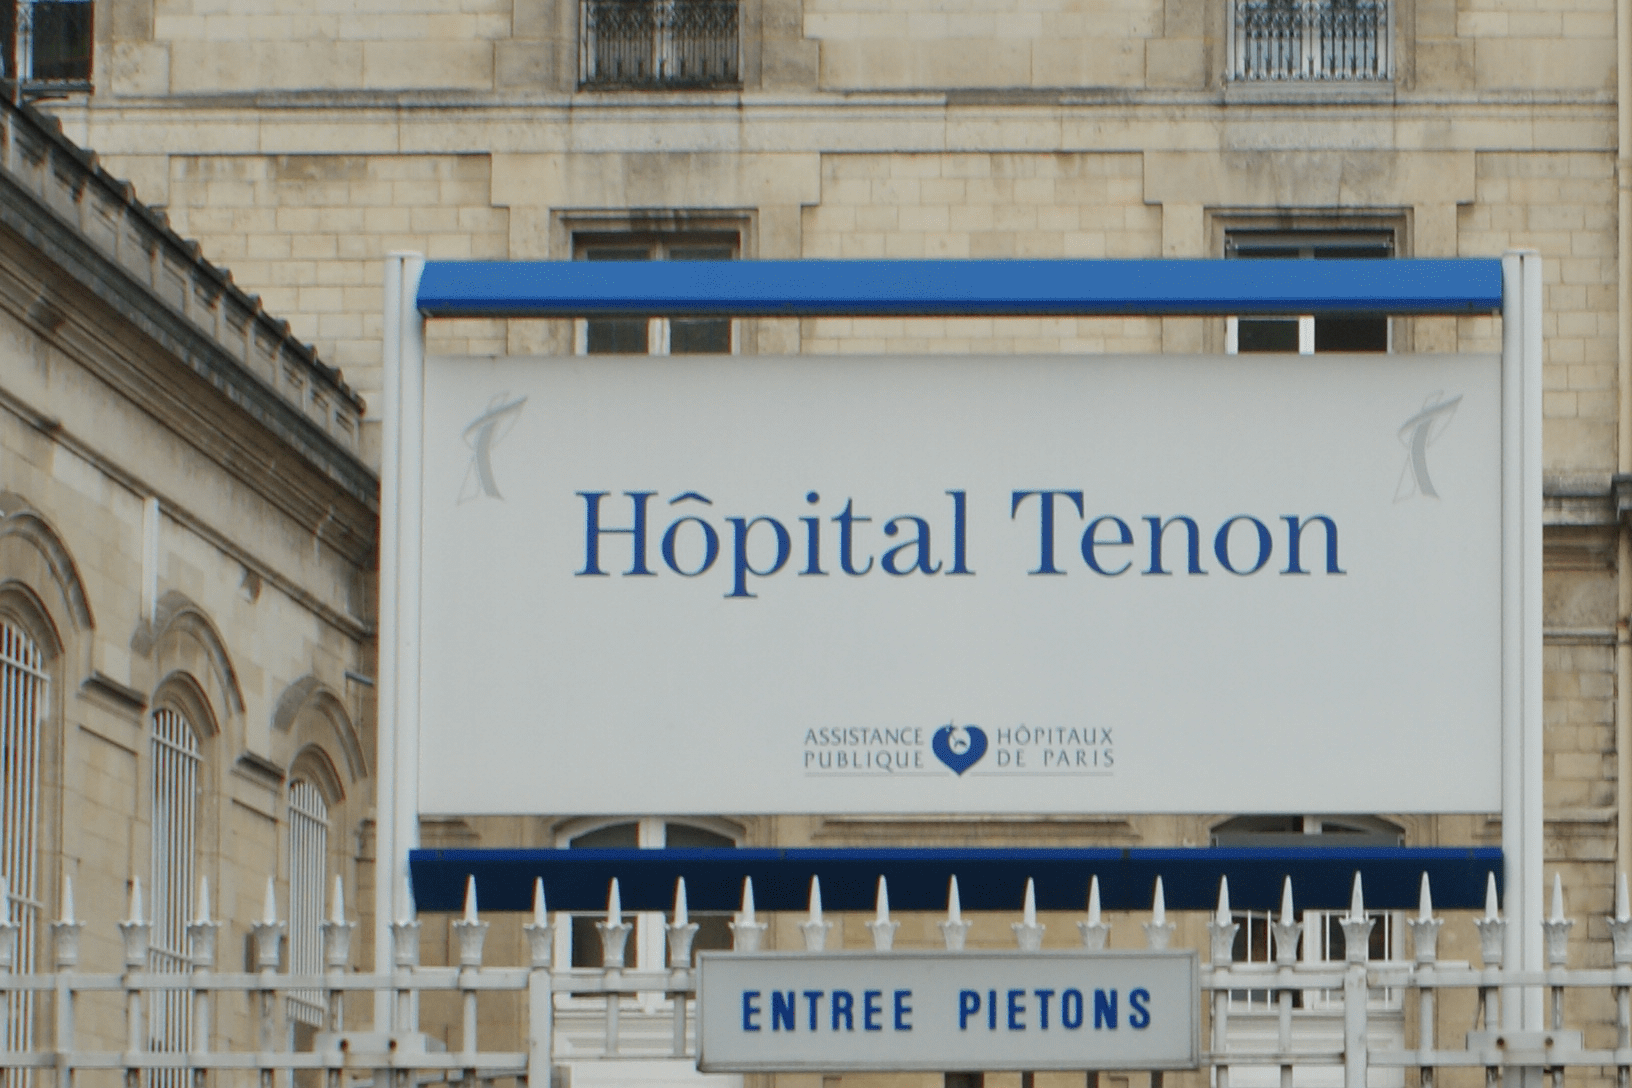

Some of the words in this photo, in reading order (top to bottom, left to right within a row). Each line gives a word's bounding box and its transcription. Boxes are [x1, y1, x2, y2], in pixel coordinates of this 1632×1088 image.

[572, 487, 977, 599] Hôpital
[1010, 488, 1348, 578] Tenon
[803, 727, 925, 746] ASSISTANCE
[997, 723, 1114, 746] HÔPITAUX
[803, 750, 925, 773] PUBLIQUE
[997, 750, 1027, 768] DE
[1043, 749, 1115, 768] PARIS
[741, 990, 914, 1032] ENTREE
[958, 987, 1152, 1030] PIETONS
